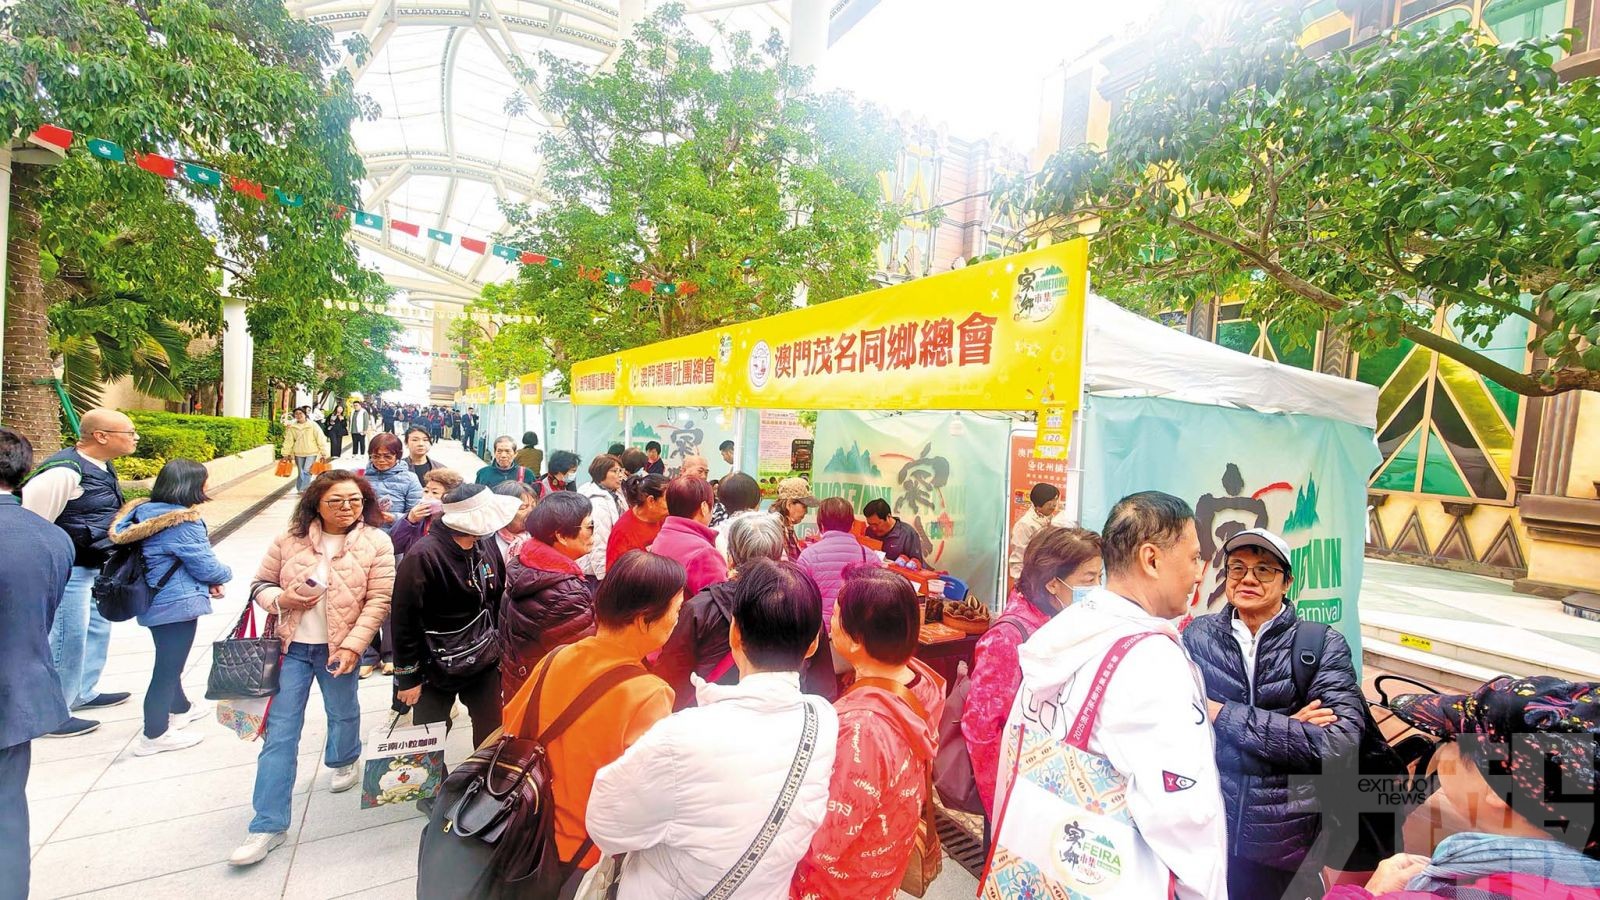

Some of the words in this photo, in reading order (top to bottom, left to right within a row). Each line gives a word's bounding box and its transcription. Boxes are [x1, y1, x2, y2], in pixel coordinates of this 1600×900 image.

[1035, 275, 1070, 292] HOMETOWN
[774, 311, 998, 379] 澳門茂名同鄉總會
[1297, 600, 1341, 622] arnival
[377, 737, 438, 753] 云南小粒咖啡
[779, 750, 810, 810] CHRISTIAN
[1082, 841, 1121, 867] FEIRA
